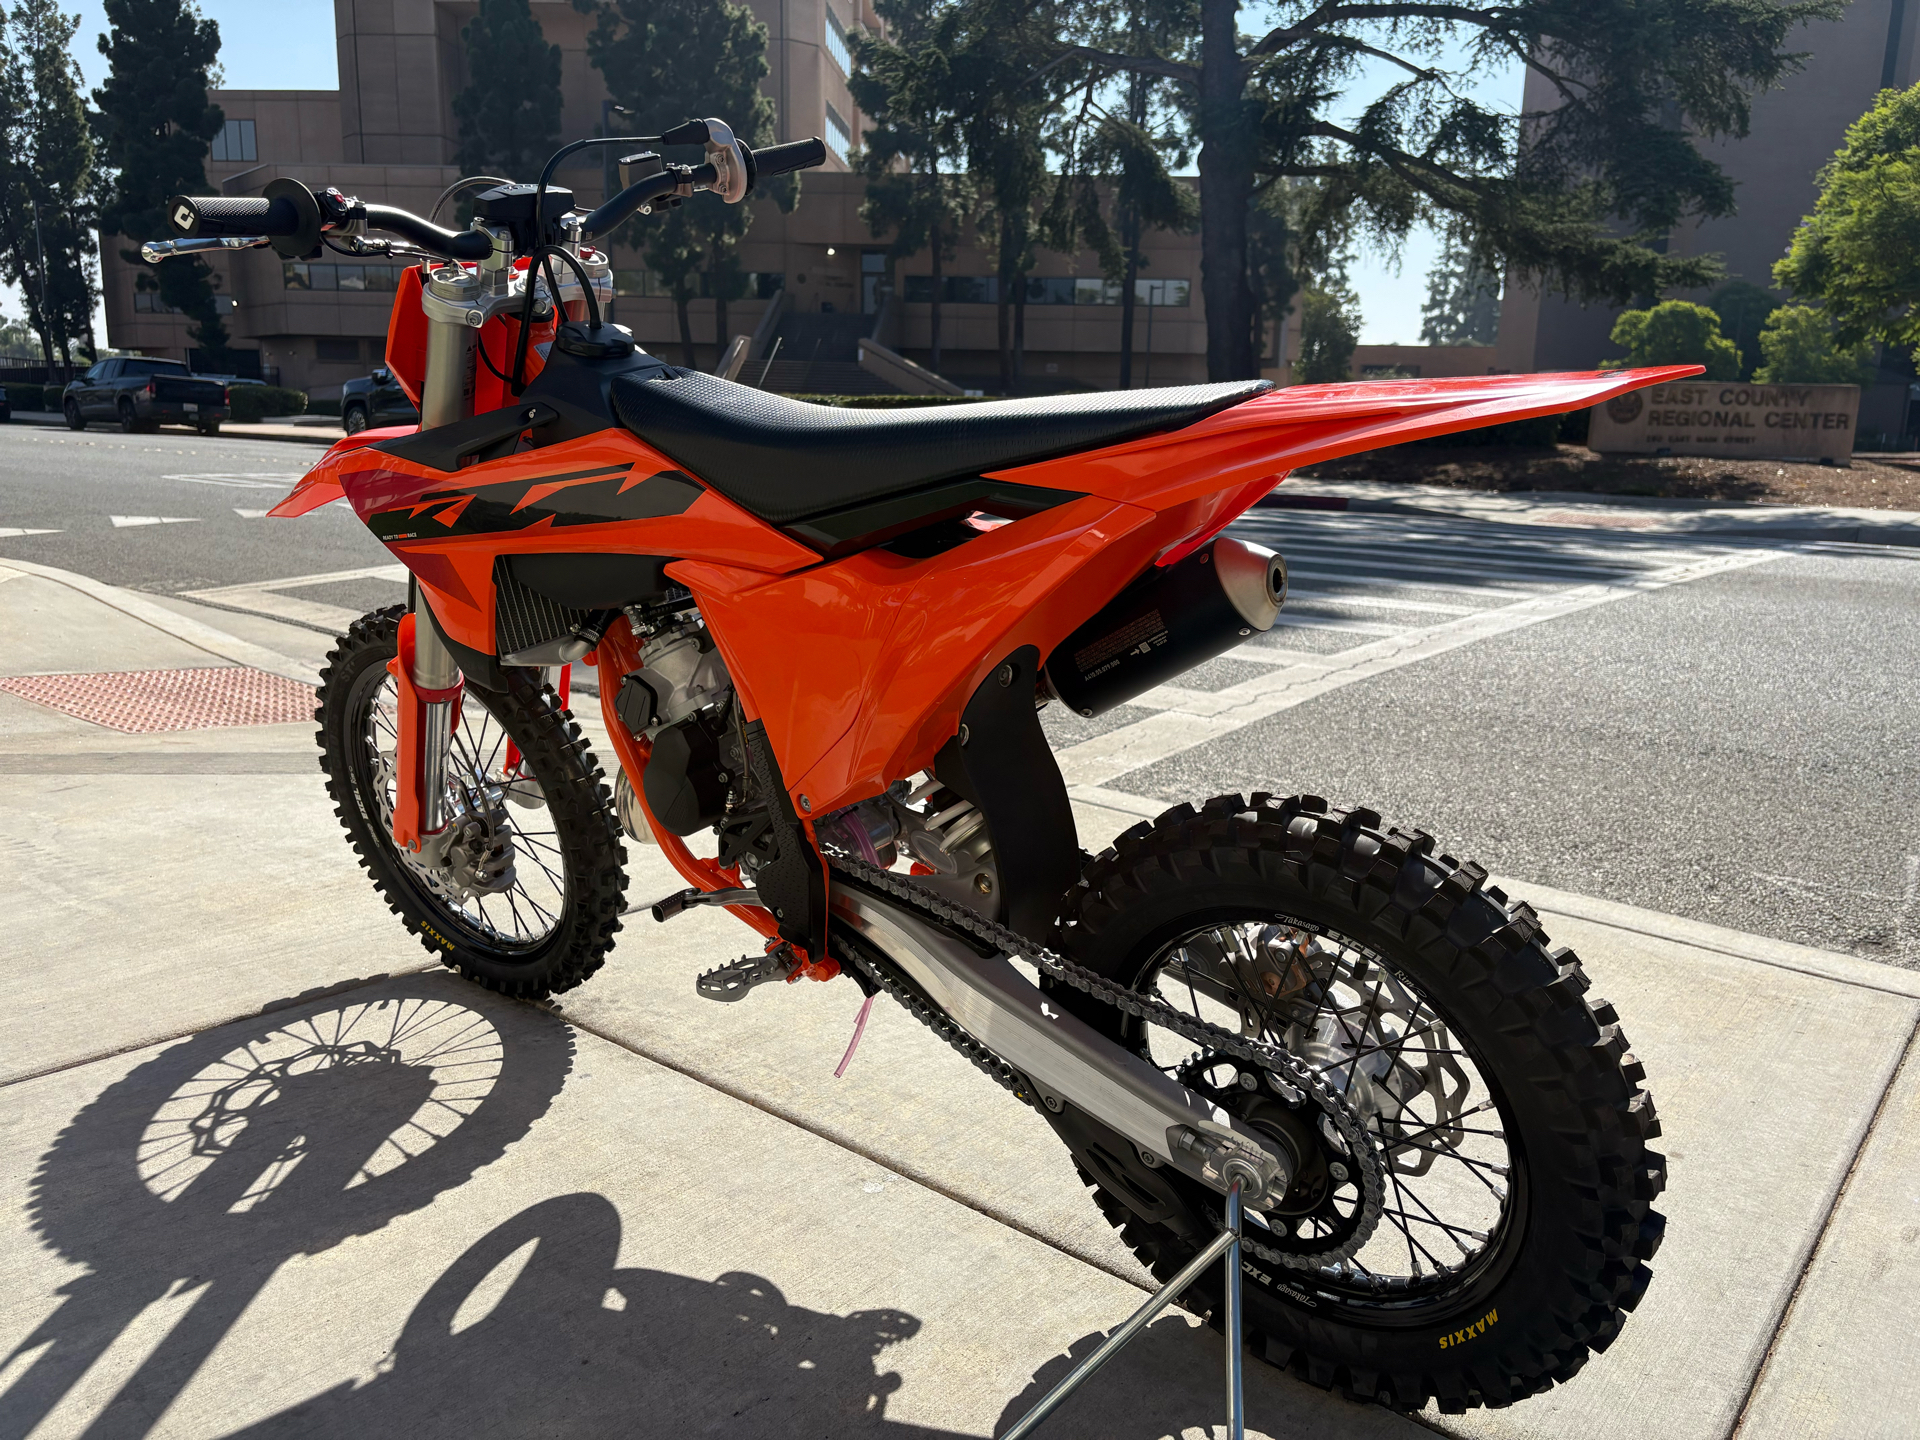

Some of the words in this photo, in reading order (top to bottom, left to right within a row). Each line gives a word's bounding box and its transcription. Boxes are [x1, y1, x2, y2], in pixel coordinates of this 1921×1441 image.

[1651, 388, 1708, 406] EAST
[1718, 388, 1811, 408] COUNTY
[1647, 410, 1755, 428] REGIONAL
[1764, 411, 1849, 430] CENTER
[420, 920, 456, 951] MAXXIS
[1274, 913, 1320, 932] Takasago
[1326, 928, 1386, 967] EXCEL
[1276, 1283, 1318, 1308] Takasago
[1438, 1308, 1499, 1350] MAXXIS
